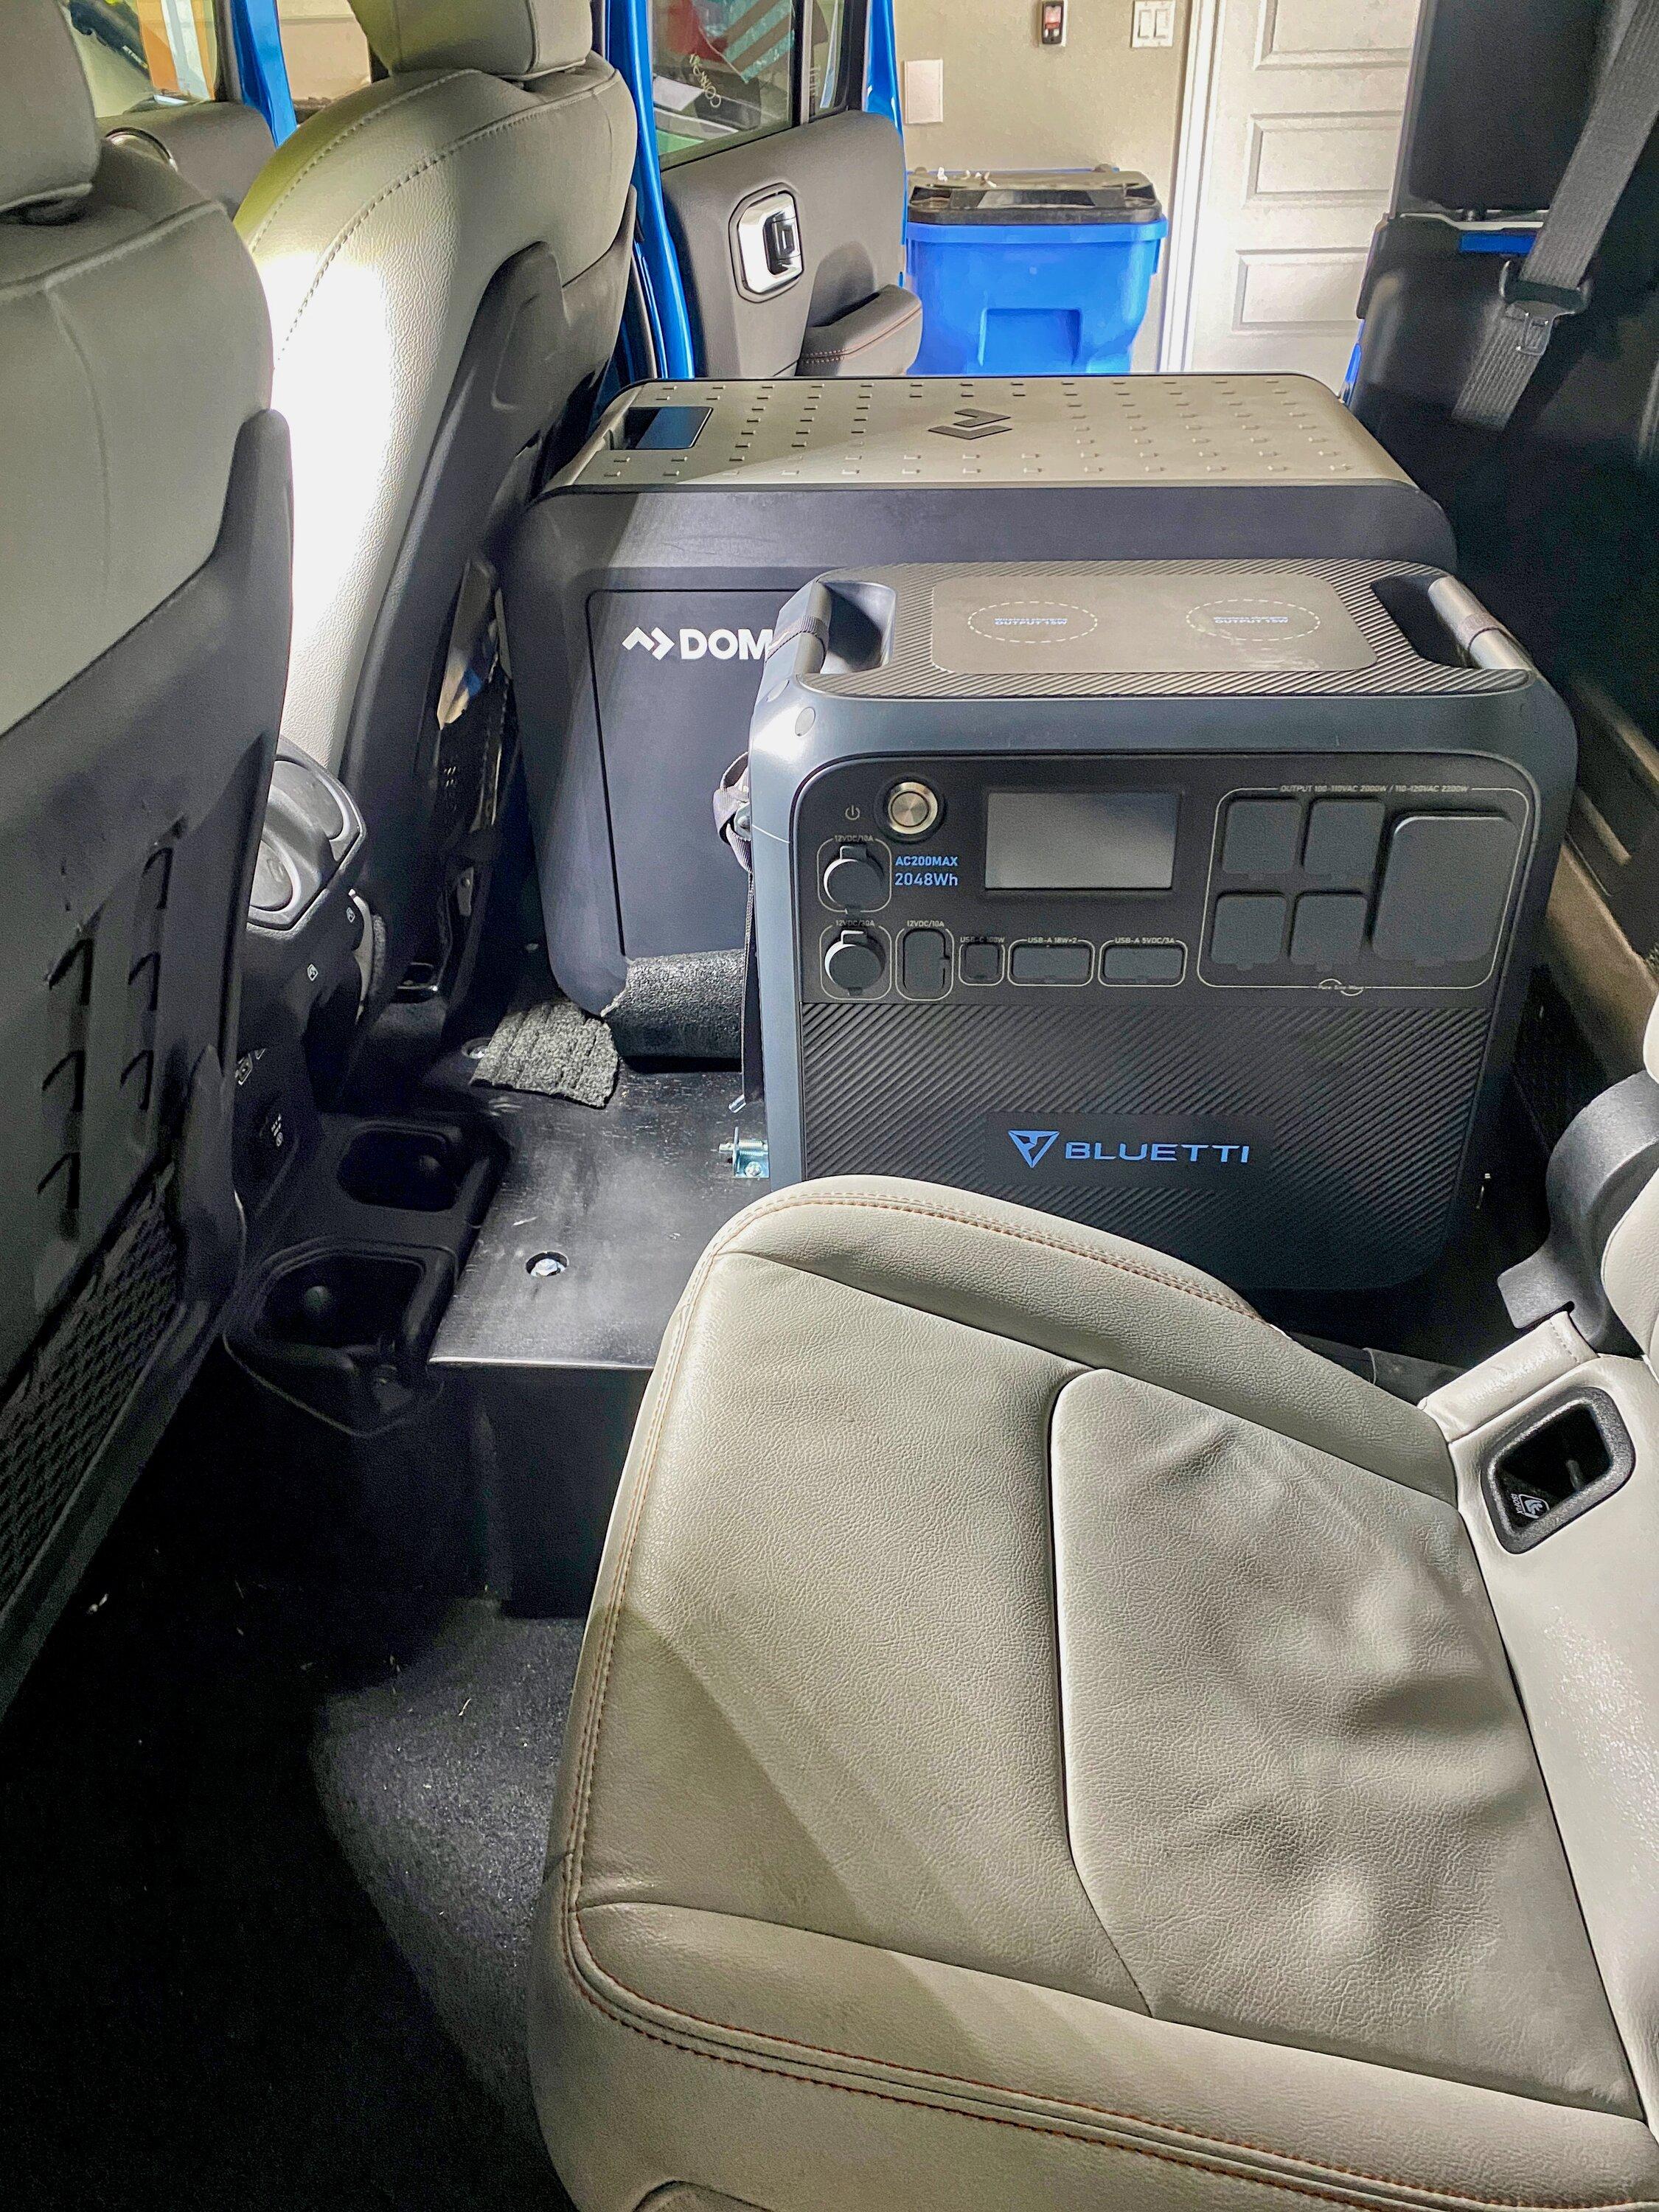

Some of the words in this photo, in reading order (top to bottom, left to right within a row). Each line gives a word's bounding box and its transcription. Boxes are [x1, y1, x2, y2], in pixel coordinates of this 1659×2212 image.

[1279, 785, 1313, 793] OUTPUT
[894, 856, 959, 866] AC200MAX
[894, 872, 959, 886] 2048Wh
[906, 919, 945, 928] 12VDC/10A
[1065, 1142, 1250, 1163] BLUETTI
